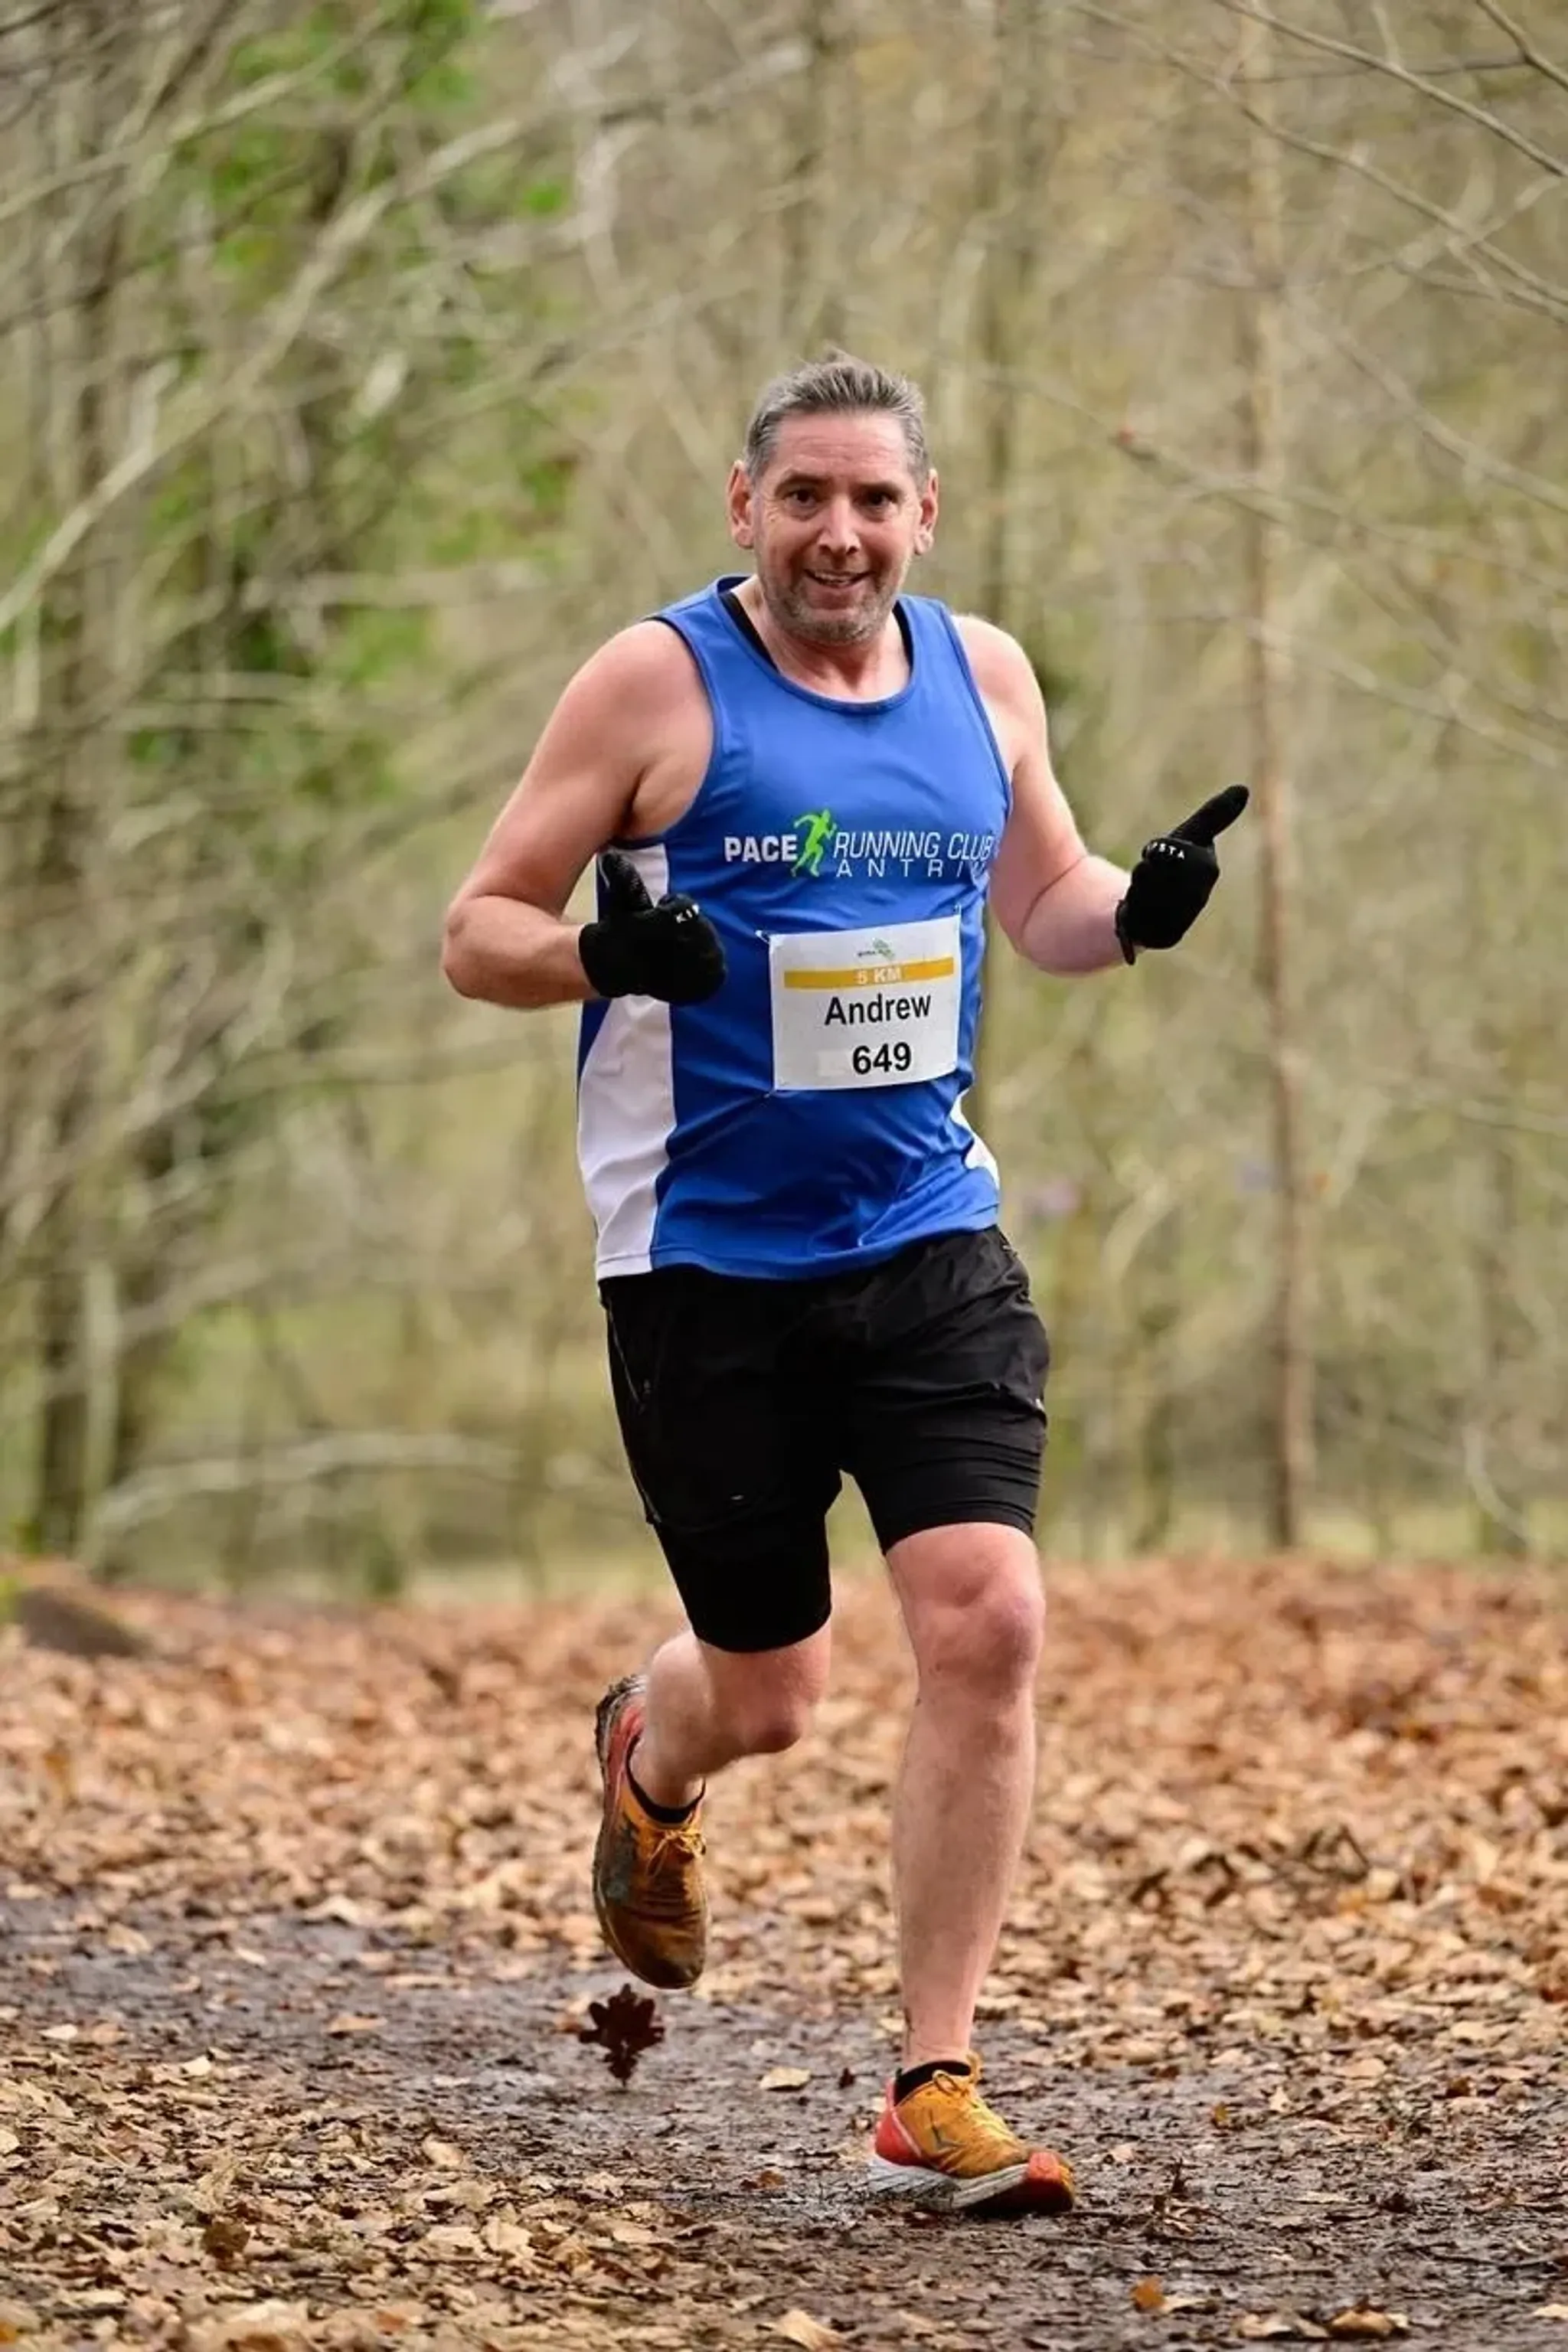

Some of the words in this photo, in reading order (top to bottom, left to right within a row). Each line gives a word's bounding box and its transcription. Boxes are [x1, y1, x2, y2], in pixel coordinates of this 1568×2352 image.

[724, 835, 798, 862] PACE
[833, 831, 941, 859] RUNNING
[947, 831, 994, 861] CLUB
[857, 970, 867, 985] 5
[873, 966, 901, 984] KM
[824, 992, 931, 1026] Andrew
[852, 1041, 912, 1075] 649
